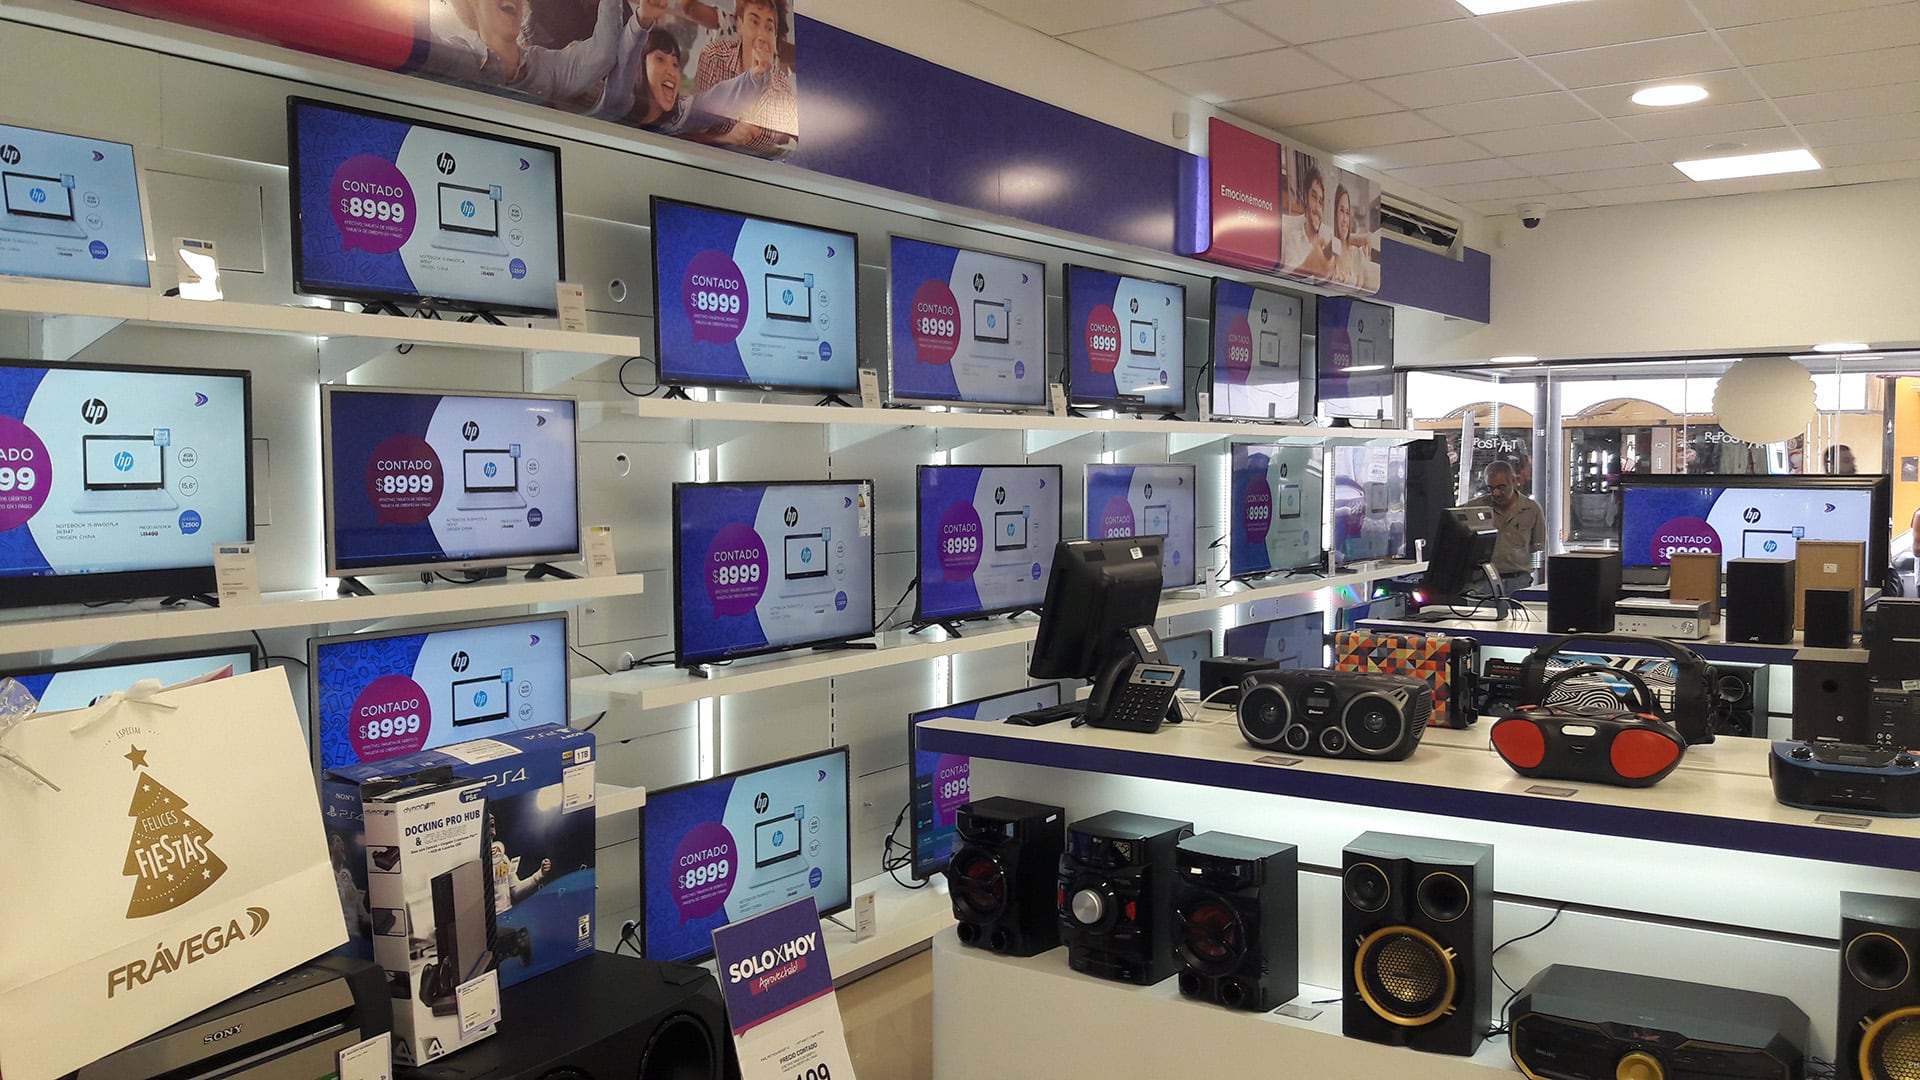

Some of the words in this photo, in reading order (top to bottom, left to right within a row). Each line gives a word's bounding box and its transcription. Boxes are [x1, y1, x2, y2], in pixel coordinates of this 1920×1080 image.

[1, 144, 21, 165] hp
[436, 152, 456, 175] hp
[342, 179, 404, 198] CONTADO
[340, 197, 405, 223] $8999
[460, 200, 475, 218] hp
[764, 244, 779, 266] hp
[691, 275, 739, 290] CONTADO
[690, 291, 741, 314] $8999
[917, 302, 953, 316] CONTADO
[917, 317, 954, 337] $8999
[1090, 323, 1116, 334] CONTADO
[81, 398, 108, 425] hp
[462, 420, 480, 441] hp
[114, 451, 134, 472] hp
[377, 459, 432, 471] CONTADO
[483, 461, 497, 478] hp
[375, 475, 433, 494] $8999
[784, 506, 799, 528] hp
[1104, 515, 1131, 525] CONTADO
[1743, 507, 1761, 524] hp
[943, 523, 977, 534] CONTADO
[942, 536, 977, 554] $8999
[1660, 535, 1712, 544] CONTADO
[713, 548, 760, 562] CONTADO
[712, 563, 760, 585] $8999
[451, 651, 470, 673] hp
[360, 698, 419, 718] CONTADO
[473, 690, 488, 708] hp
[115, 726, 142, 740] ESPECIAL
[359, 713, 421, 740] $8999
[483, 767, 527, 788] PS4
[940, 763, 969, 780] CONTAD
[335, 793, 355, 801] SONY
[754, 792, 770, 815] hp
[141, 810, 178, 833] FELICES
[405, 818, 444, 837] DOCKING
[445, 814, 462, 827] PRO
[464, 809, 481, 822] HUB
[415, 836, 422, 846] &
[135, 834, 209, 879] FIESTAS
[679, 843, 728, 867] CONTADO
[678, 859, 729, 890] $8999
[107, 918, 246, 999] FRÁVEGA
[203, 1023, 244, 1045] SONY
[796, 1042, 818, 1057] CONTADO
